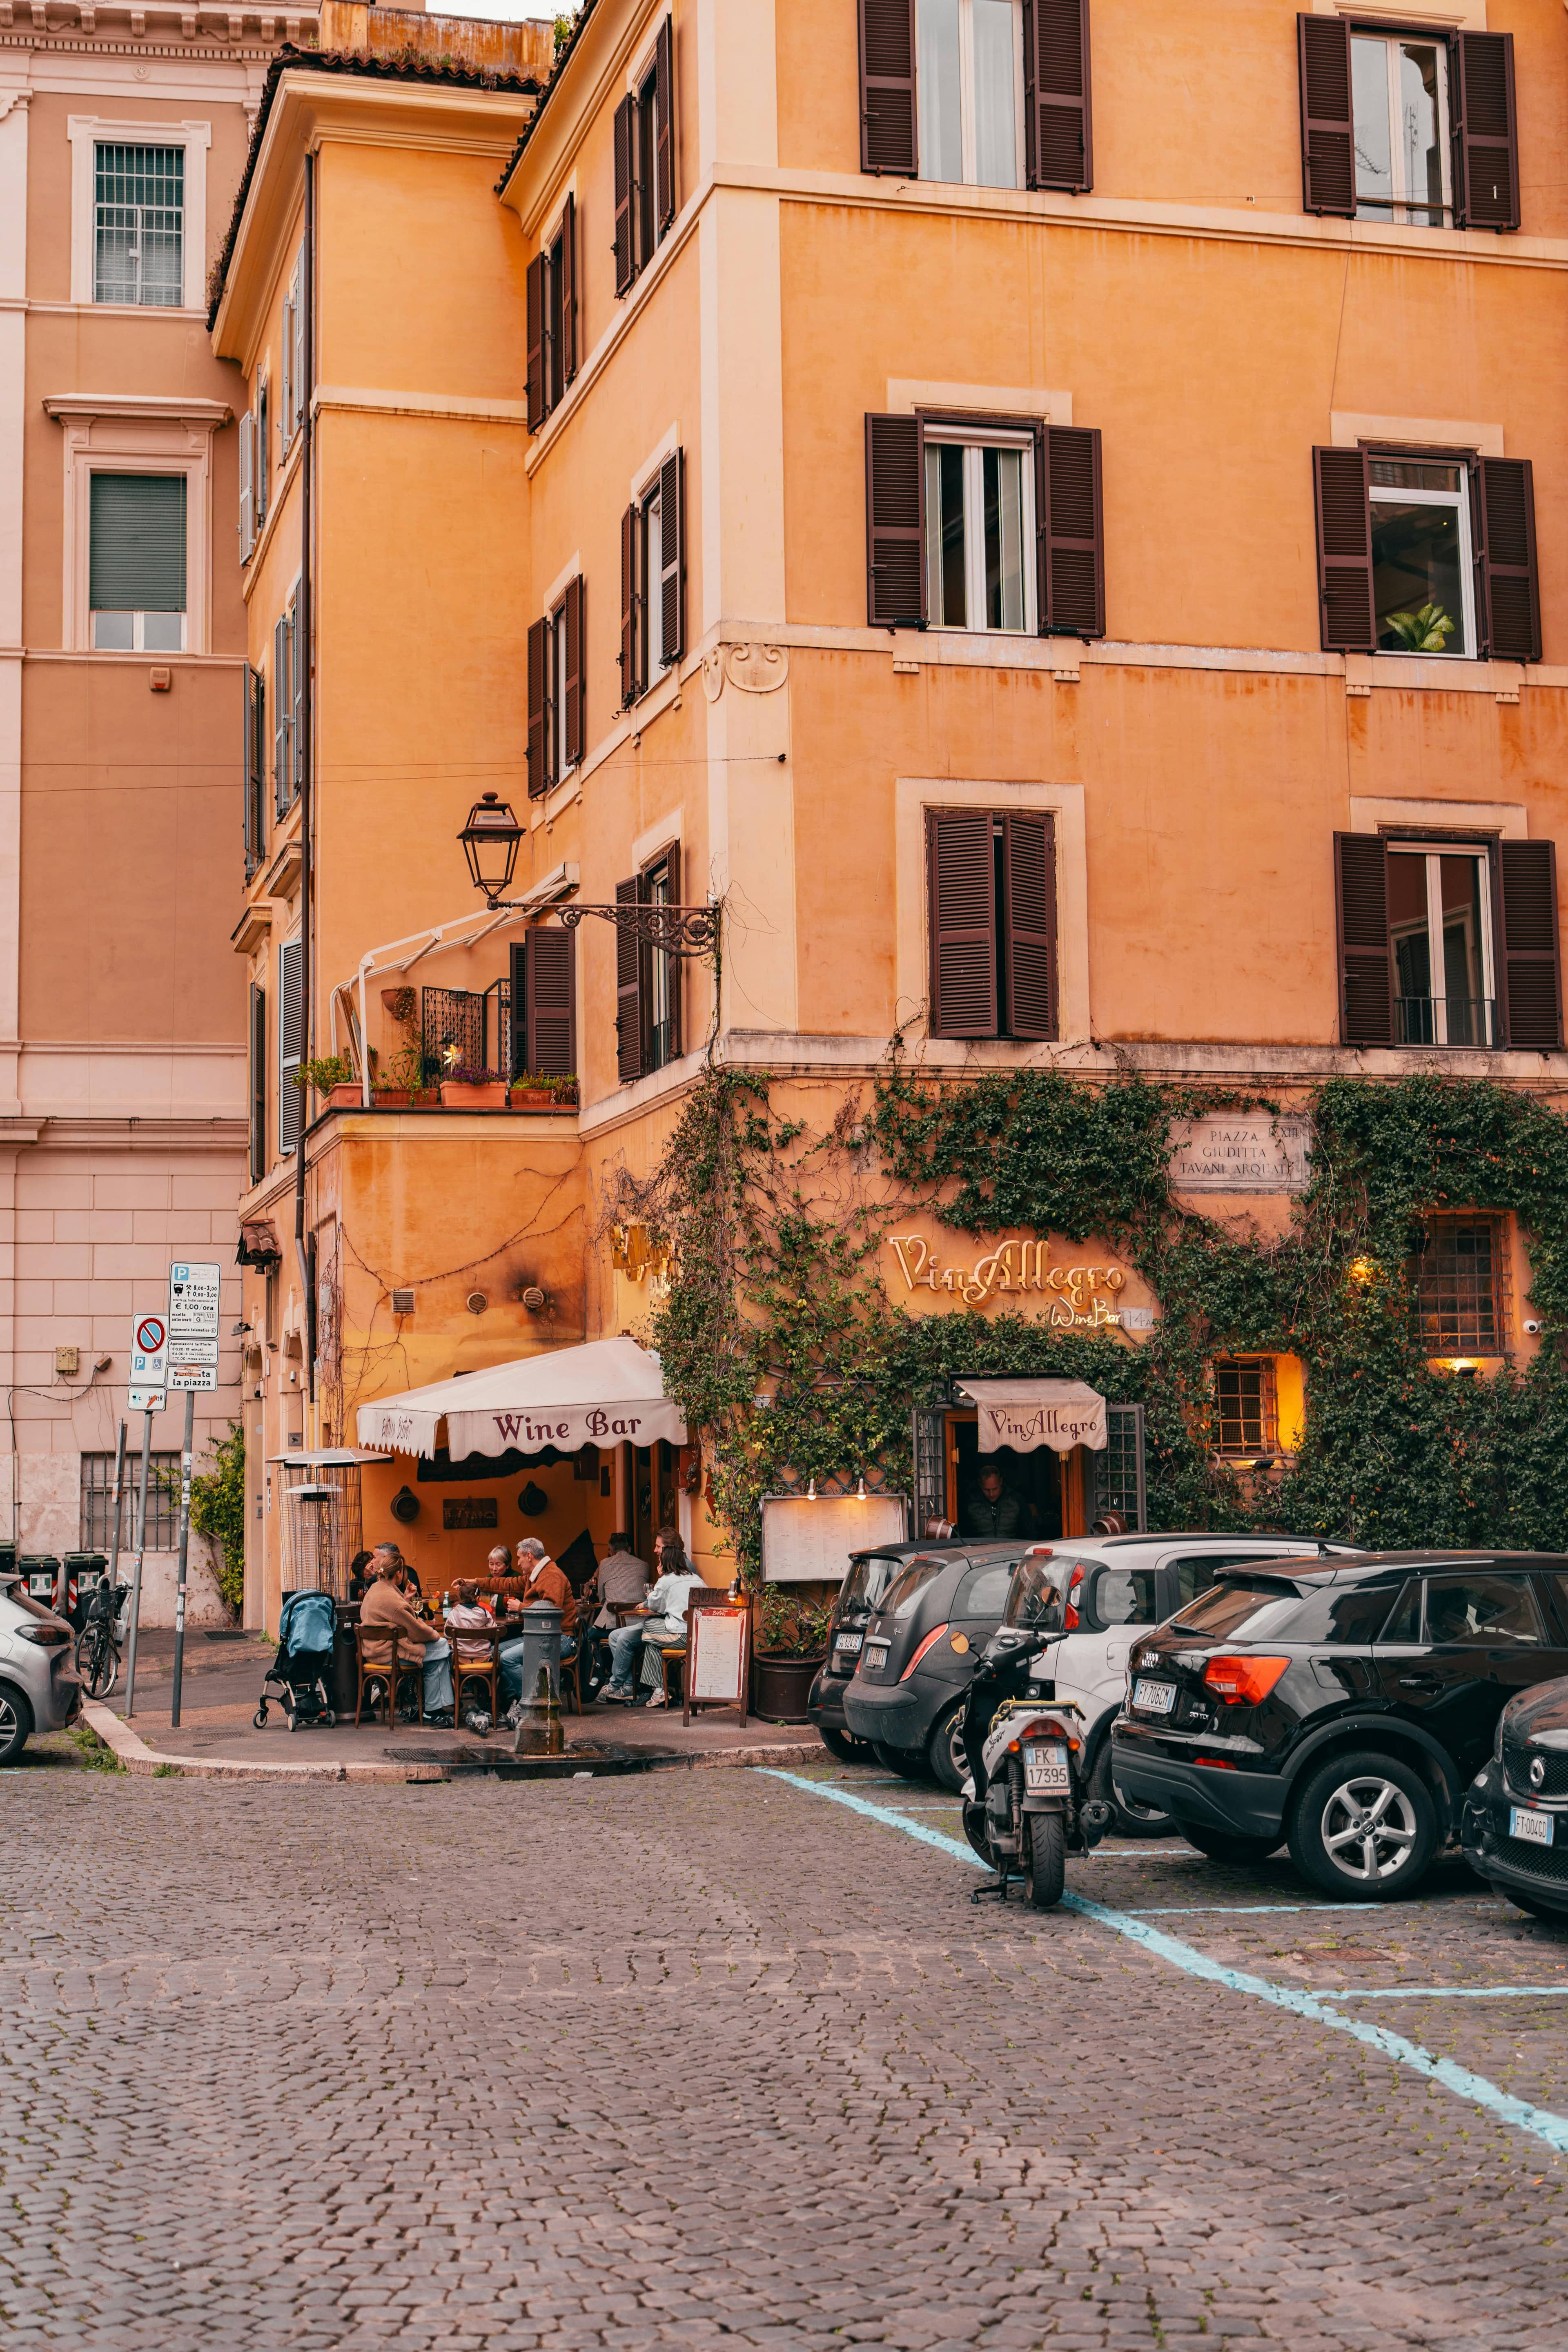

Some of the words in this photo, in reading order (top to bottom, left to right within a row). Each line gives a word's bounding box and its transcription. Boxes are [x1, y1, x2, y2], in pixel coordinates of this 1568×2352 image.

[1211, 1131, 1258, 1142] PIAZZA
[1203, 1147, 1266, 1158] GIUDITTA
[1180, 1163, 1224, 1174] TAVANI
[1233, 1164, 1291, 1177] ARQUATI
[184, 1379, 211, 1387] piazza
[493, 1414, 570, 1442] Wine
[586, 1408, 642, 1437] Bar
[1035, 1749, 1050, 1764] FK
[1029, 1768, 1067, 1784] 17395
